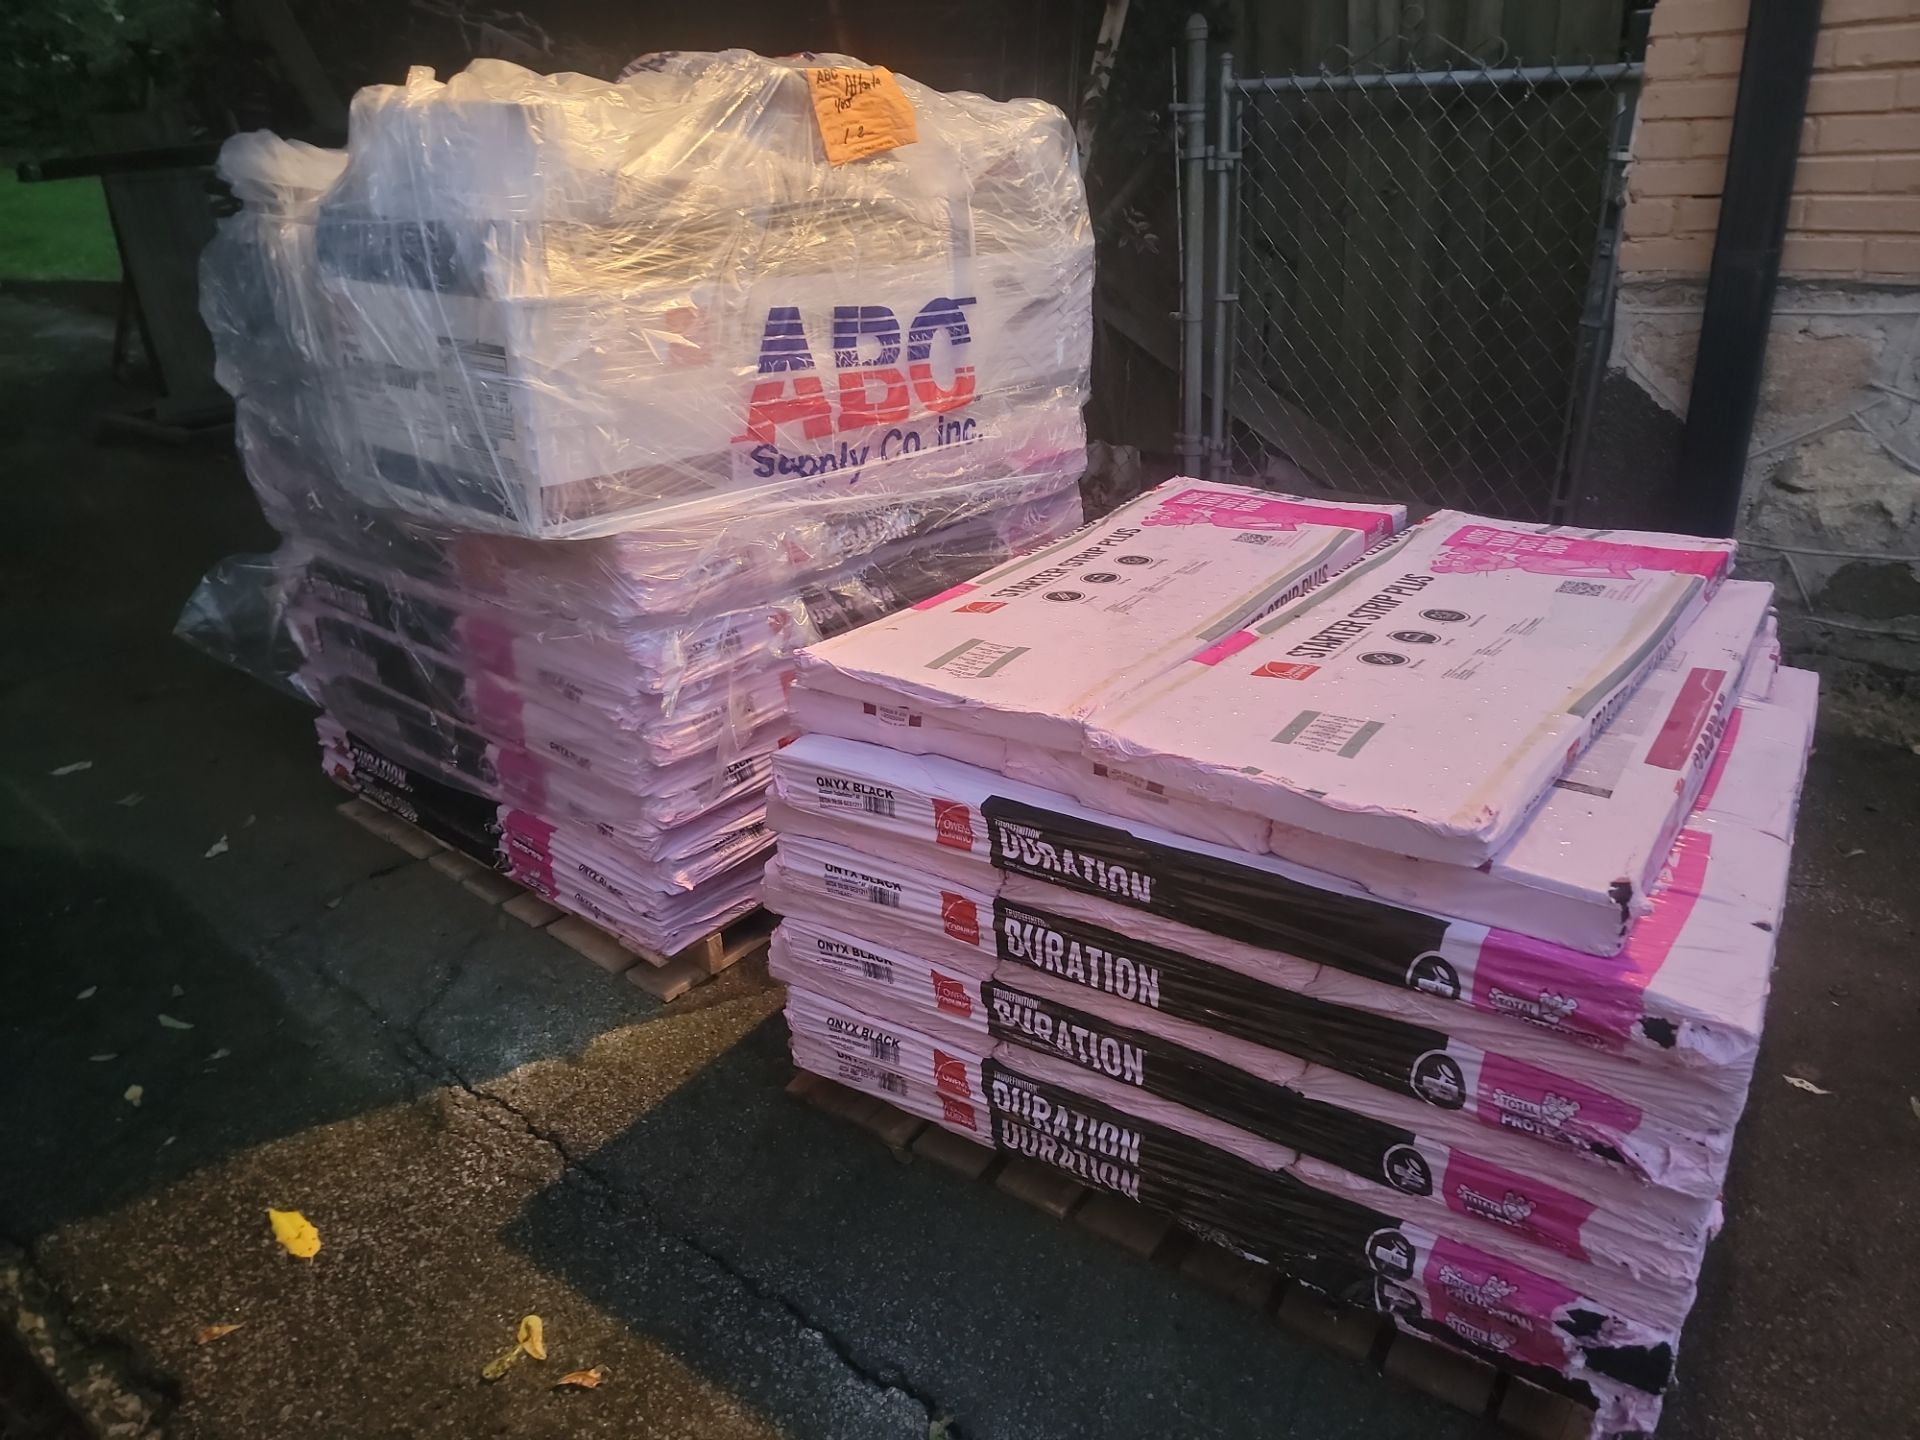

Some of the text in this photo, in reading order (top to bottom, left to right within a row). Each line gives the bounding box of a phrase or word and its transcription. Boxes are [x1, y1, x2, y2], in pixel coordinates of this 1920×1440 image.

[816, 69, 838, 83] ABC
[732, 297, 977, 443] ABC
[990, 567, 1073, 598] STARTER
[1058, 546, 1108, 567] STRIP
[1097, 527, 1142, 547] PLUS
[1286, 619, 1374, 659] STARTER
[1347, 594, 1403, 620] STRIP
[1381, 573, 1435, 597] PLUS
[816, 776, 849, 791] ONYX
[853, 782, 895, 800] BLACK
[999, 827, 1151, 903] DURATION
[817, 940, 849, 954] ONYX
[852, 947, 894, 967] BLACK
[1005, 917, 1161, 1008] DURATION
[826, 1017, 859, 1035] ONYX
[861, 1027, 901, 1049] BLACK
[993, 1000, 1144, 1085] DURATION
[992, 1080, 1141, 1167] DURATION
